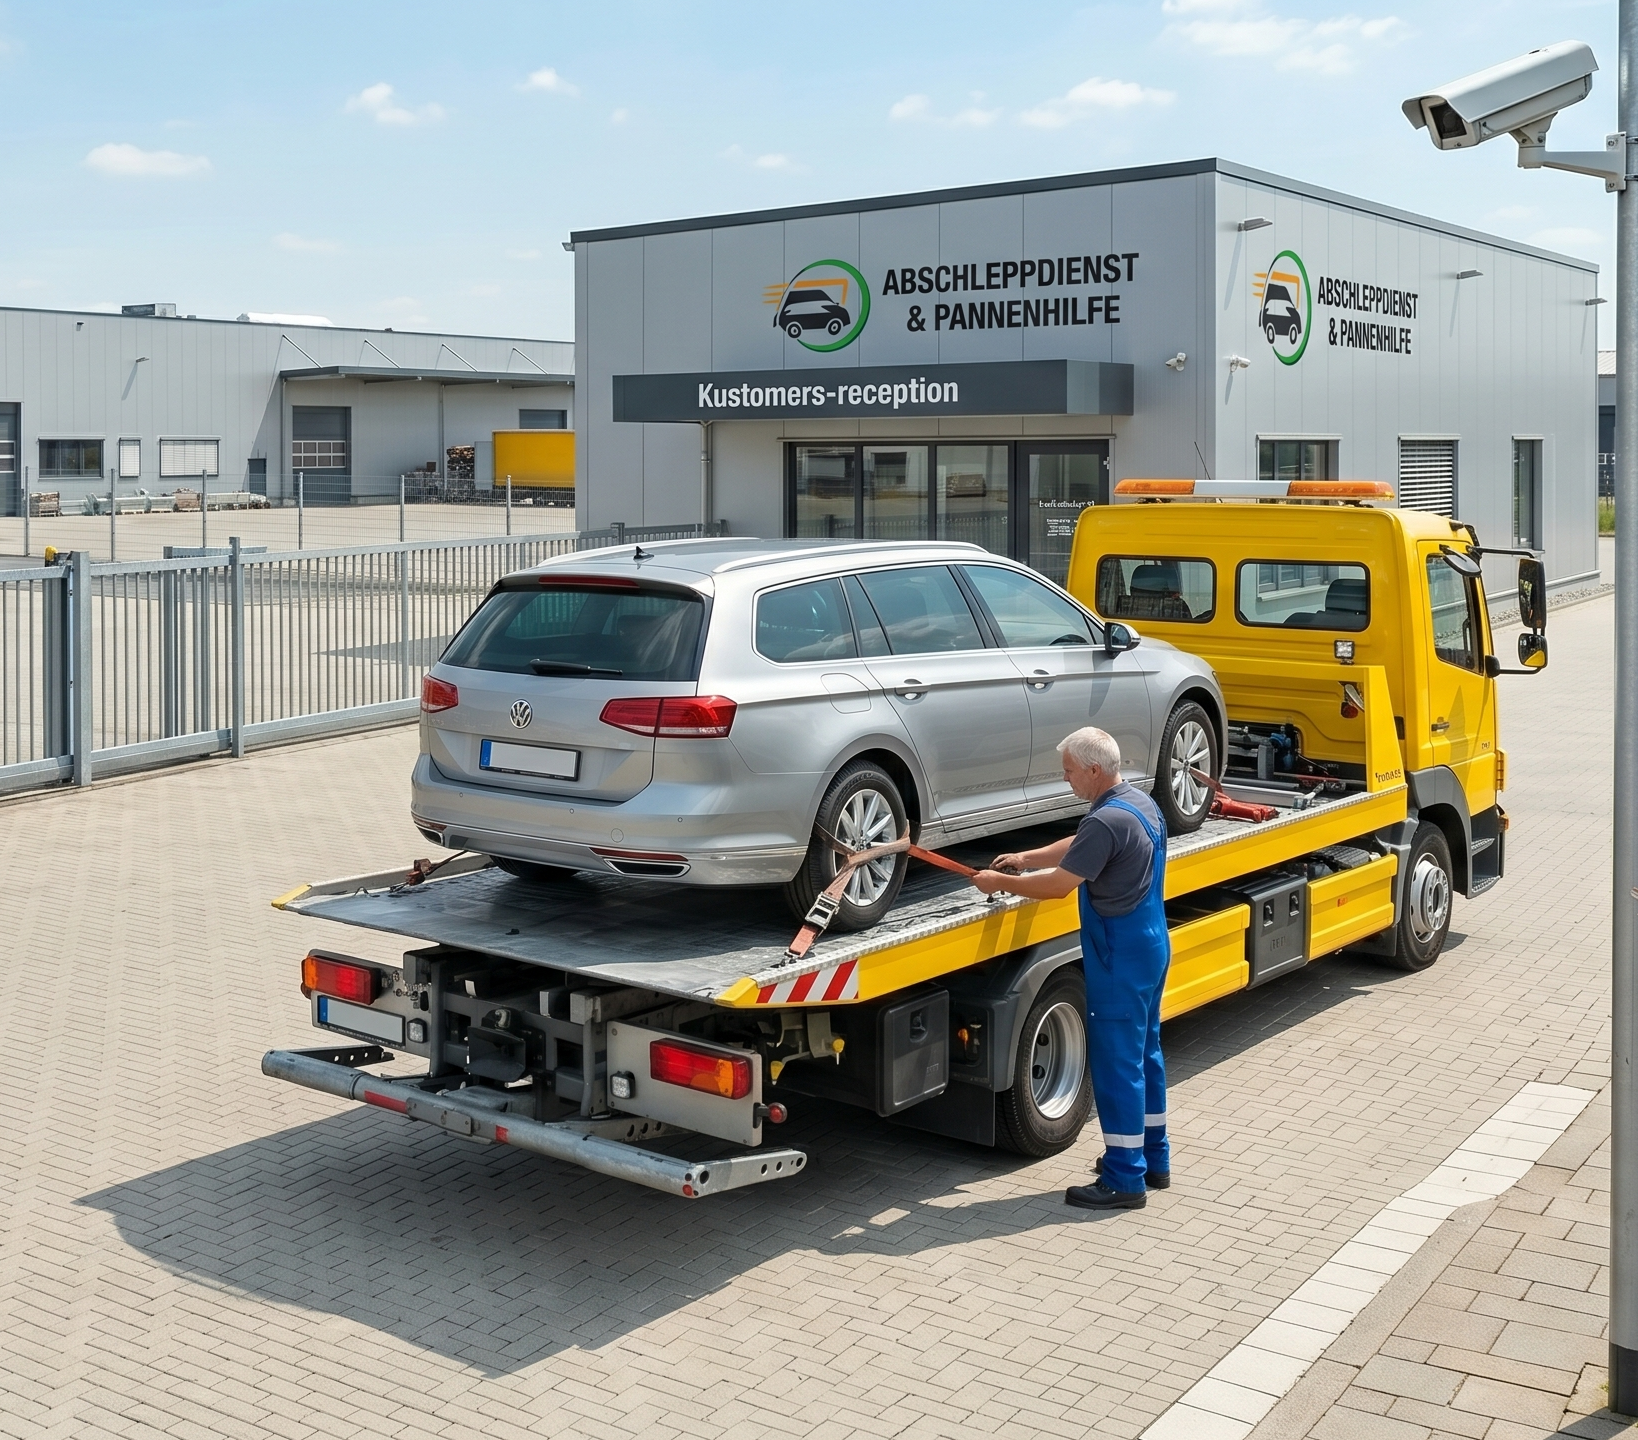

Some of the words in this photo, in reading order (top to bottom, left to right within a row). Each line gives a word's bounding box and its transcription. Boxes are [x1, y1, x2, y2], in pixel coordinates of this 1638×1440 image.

[882, 252, 1140, 296] ABSCHLEPPDIENST
[906, 305, 926, 332] &
[934, 294, 1121, 331] PANNENHILFE
[1317, 276, 1419, 319] ABSCHLEPPDIENST
[1328, 317, 1338, 346] &
[1340, 318, 1412, 355] PANNENHILFE
[698, 377, 959, 410] Kustomers-reception
